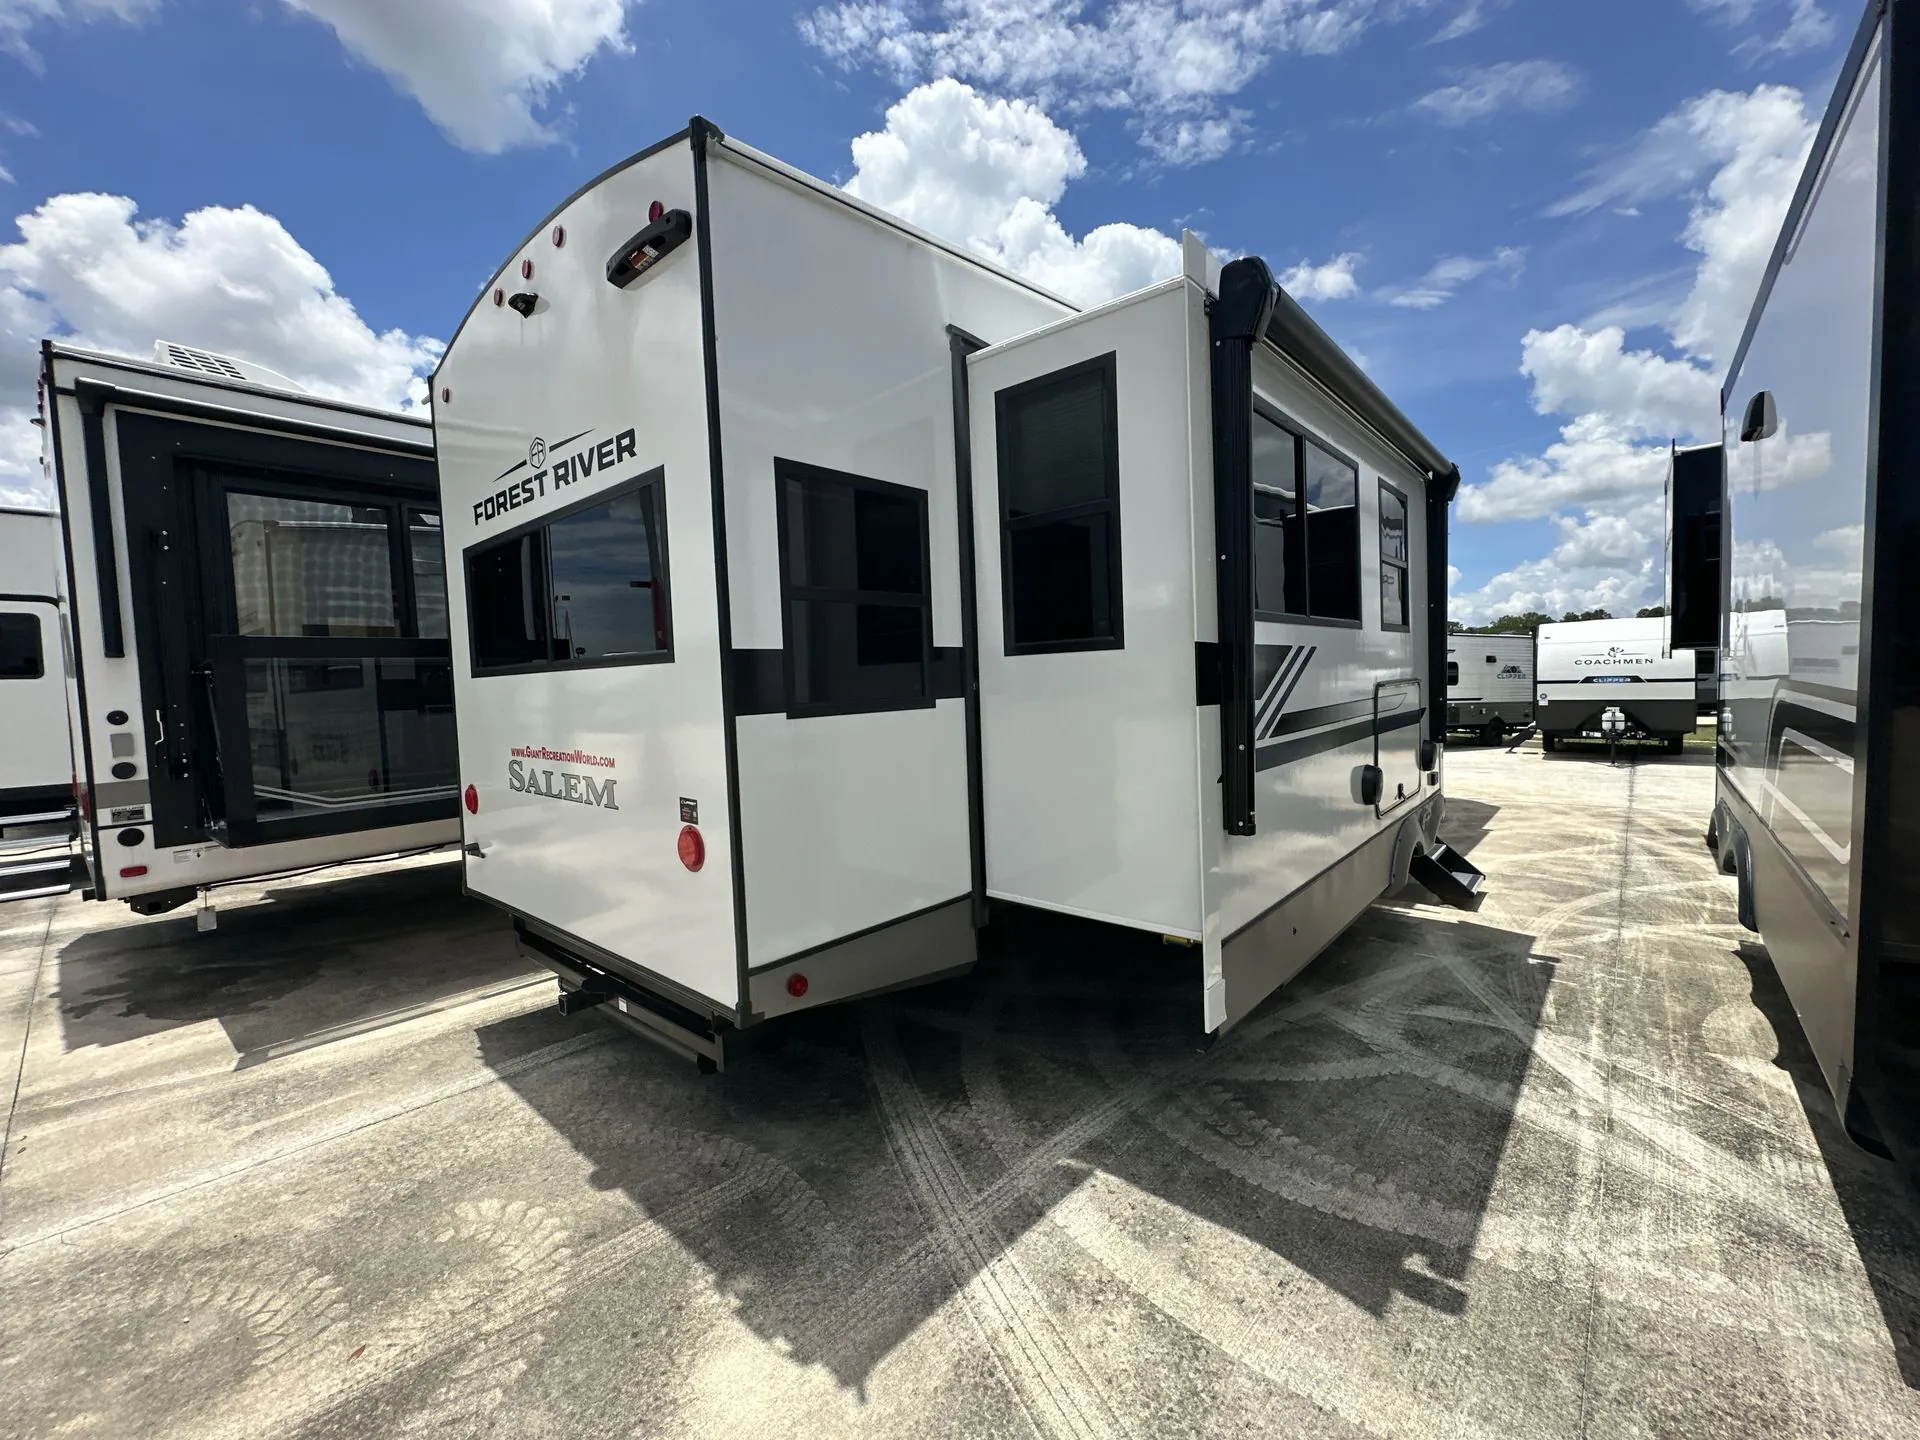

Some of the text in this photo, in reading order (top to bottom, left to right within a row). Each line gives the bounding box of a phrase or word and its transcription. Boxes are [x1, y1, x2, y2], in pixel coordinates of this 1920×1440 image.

[472, 427, 637, 526] FOREST RIVER
[508, 759, 619, 810] SALEM
